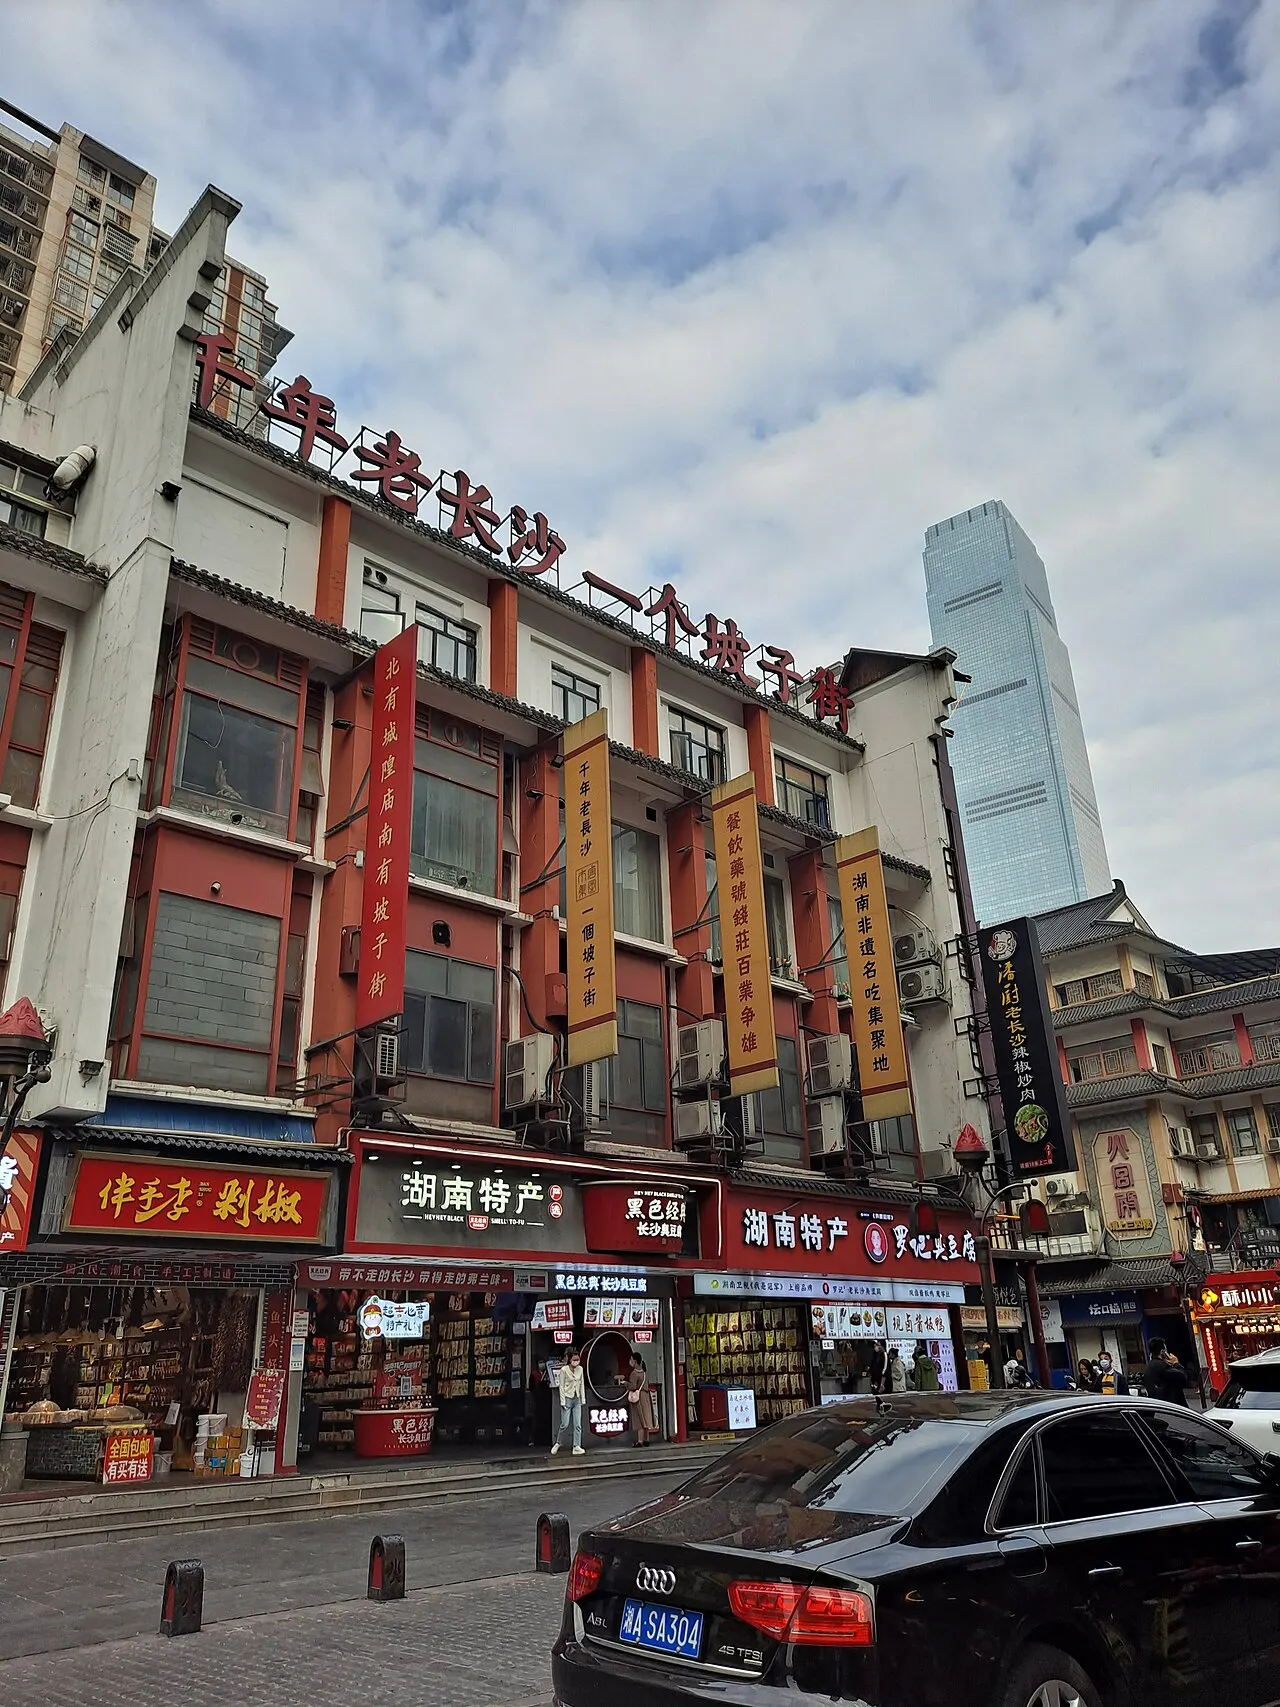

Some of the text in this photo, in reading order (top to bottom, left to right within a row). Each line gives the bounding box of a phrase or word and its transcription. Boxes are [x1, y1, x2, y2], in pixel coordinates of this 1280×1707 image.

[578, 760, 592, 857] 千年老長沙
[367, 656, 402, 1000] 北有城隍庙南有坡子街
[581, 907, 597, 1008] 一個坡子街
[852, 871, 890, 1073] 湖南非遺名吃集聚地
[212, 1178, 303, 1228] 剁椒
[400, 1170, 545, 1215] 湖南特产
[550, 1186, 562, 1217] 严选
[743, 1208, 849, 1252] 湖南特产
[338, 1267, 416, 1283] 带不走的长沙
[555, 1274, 647, 1292] 黑色经典 长沙臭豆腐
[1221, 1286, 1280, 1307] 酥小小
[382, 1303, 427, 1319] 超吉心意
[892, 1312, 945, 1333] 现卤酱板鸭
[109, 1437, 151, 1459] 全国包邮
[107, 1458, 148, 1480] 有买有送
[718, 1645, 763, 1662] 45 TFSI
